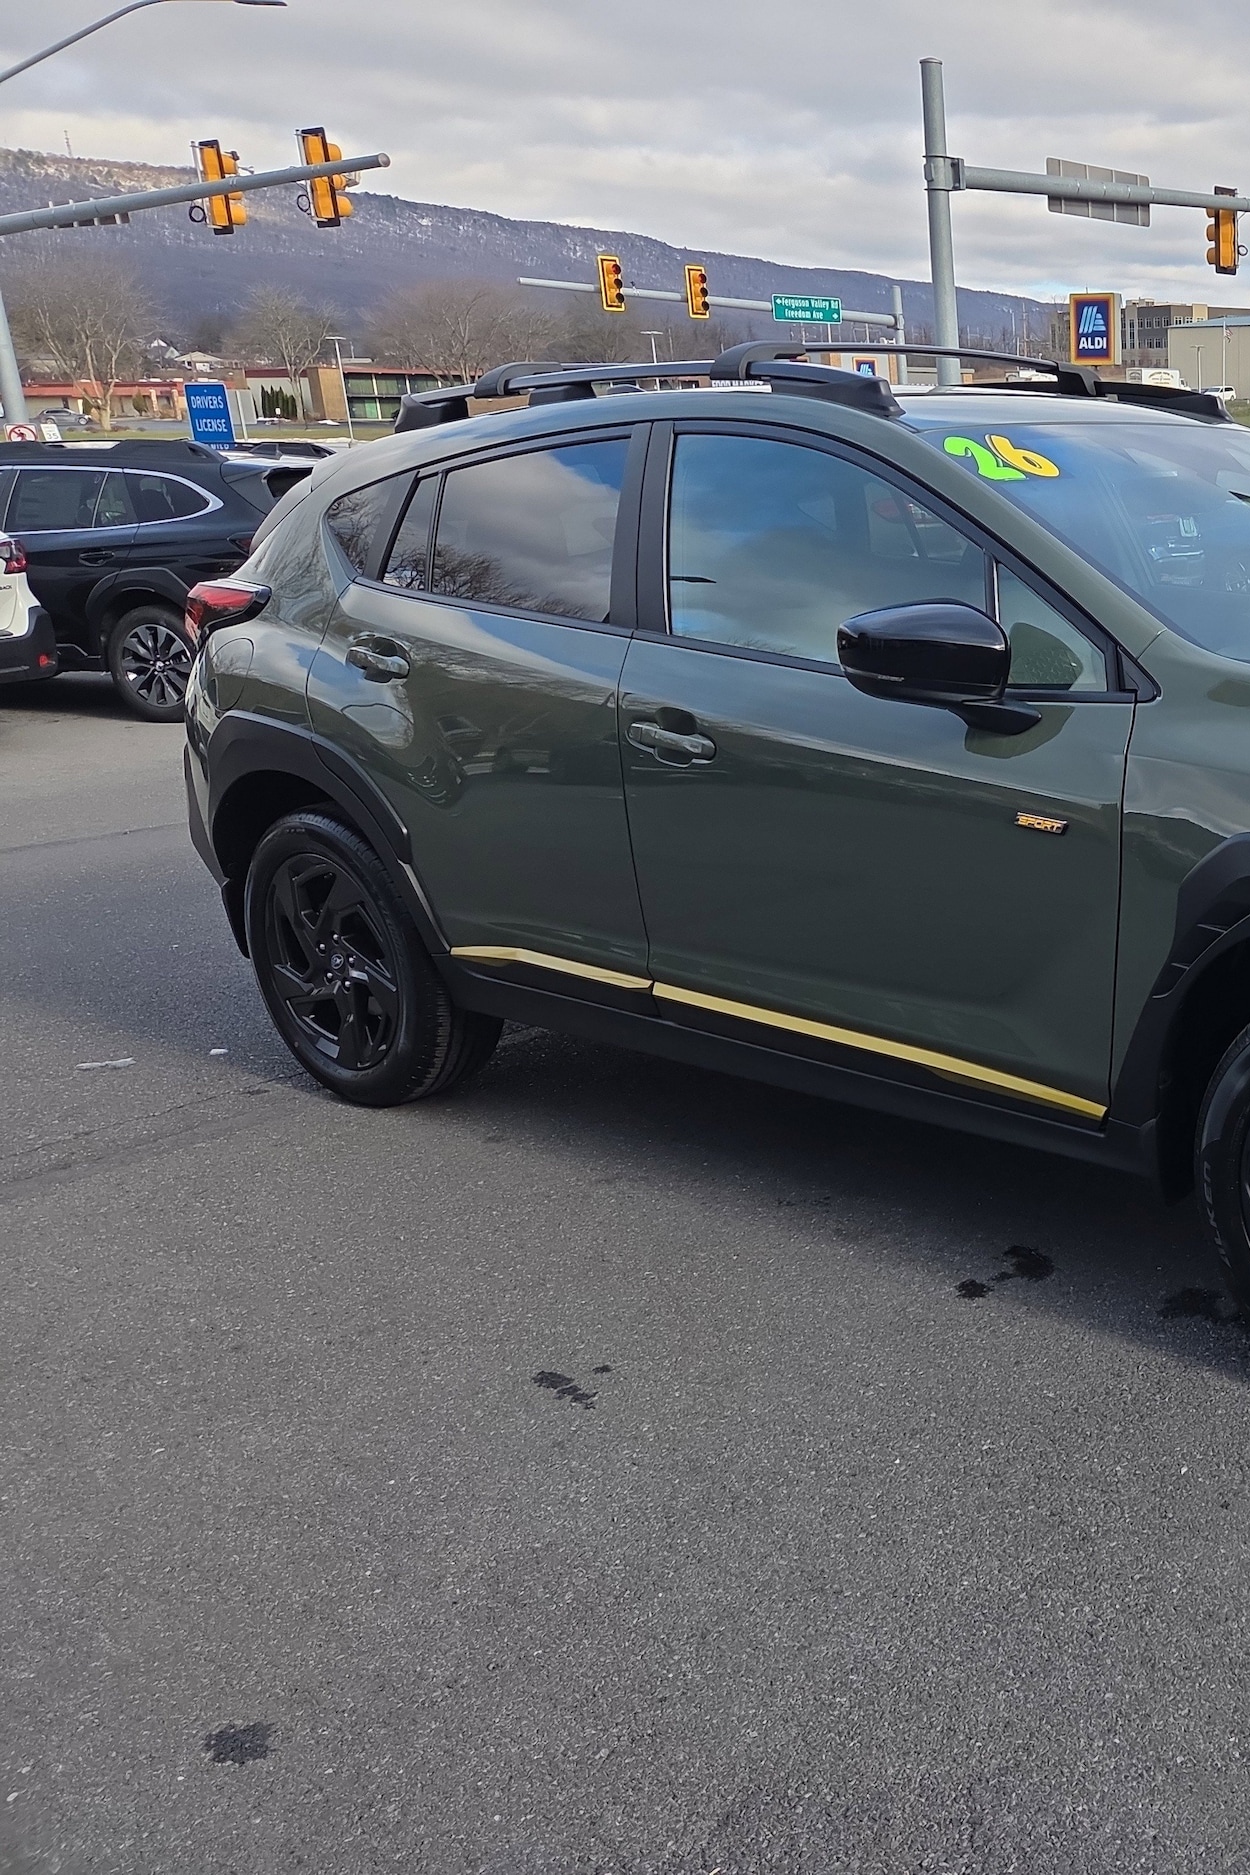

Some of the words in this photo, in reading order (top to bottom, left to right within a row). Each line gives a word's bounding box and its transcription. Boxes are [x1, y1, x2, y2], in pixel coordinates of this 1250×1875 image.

[781, 297, 809, 309] Ferguson
[810, 299, 829, 311] Valley
[830, 300, 839, 310] Rd
[784, 308, 812, 319] Freedom
[812, 310, 824, 320] Ave
[1079, 336, 1107, 350] ALDI
[190, 395, 224, 409] DRIVERS
[195, 418, 228, 432] LICENSE
[46, 432, 59, 440] 35
[943, 434, 1060, 481] 26
[1016, 815, 1064, 834] SPORT
